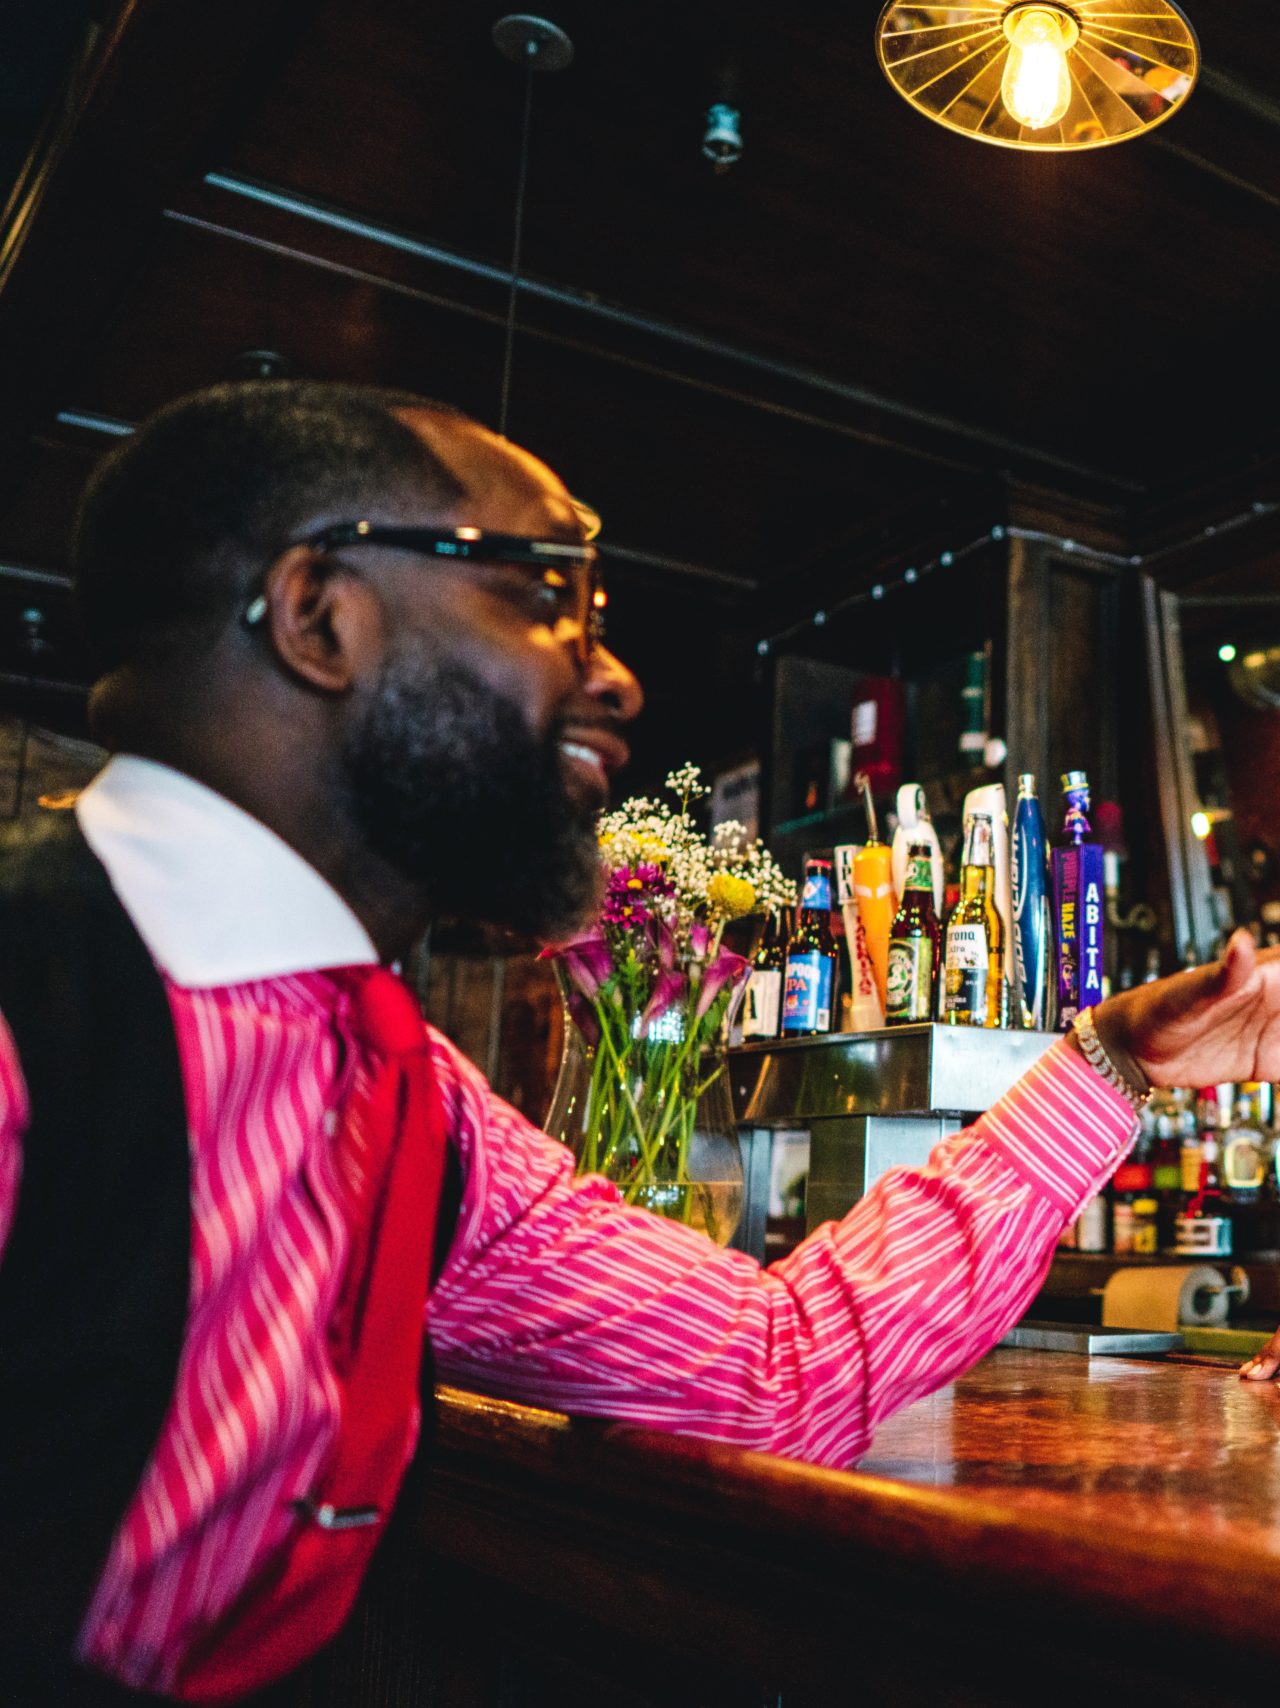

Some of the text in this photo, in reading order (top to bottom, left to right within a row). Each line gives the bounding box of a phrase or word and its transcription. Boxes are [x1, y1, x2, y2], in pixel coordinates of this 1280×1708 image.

[1060, 851, 1078, 939] PURPLE HAZE
[1086, 882, 1099, 989] ABITA
[786, 978, 808, 992] IPA
